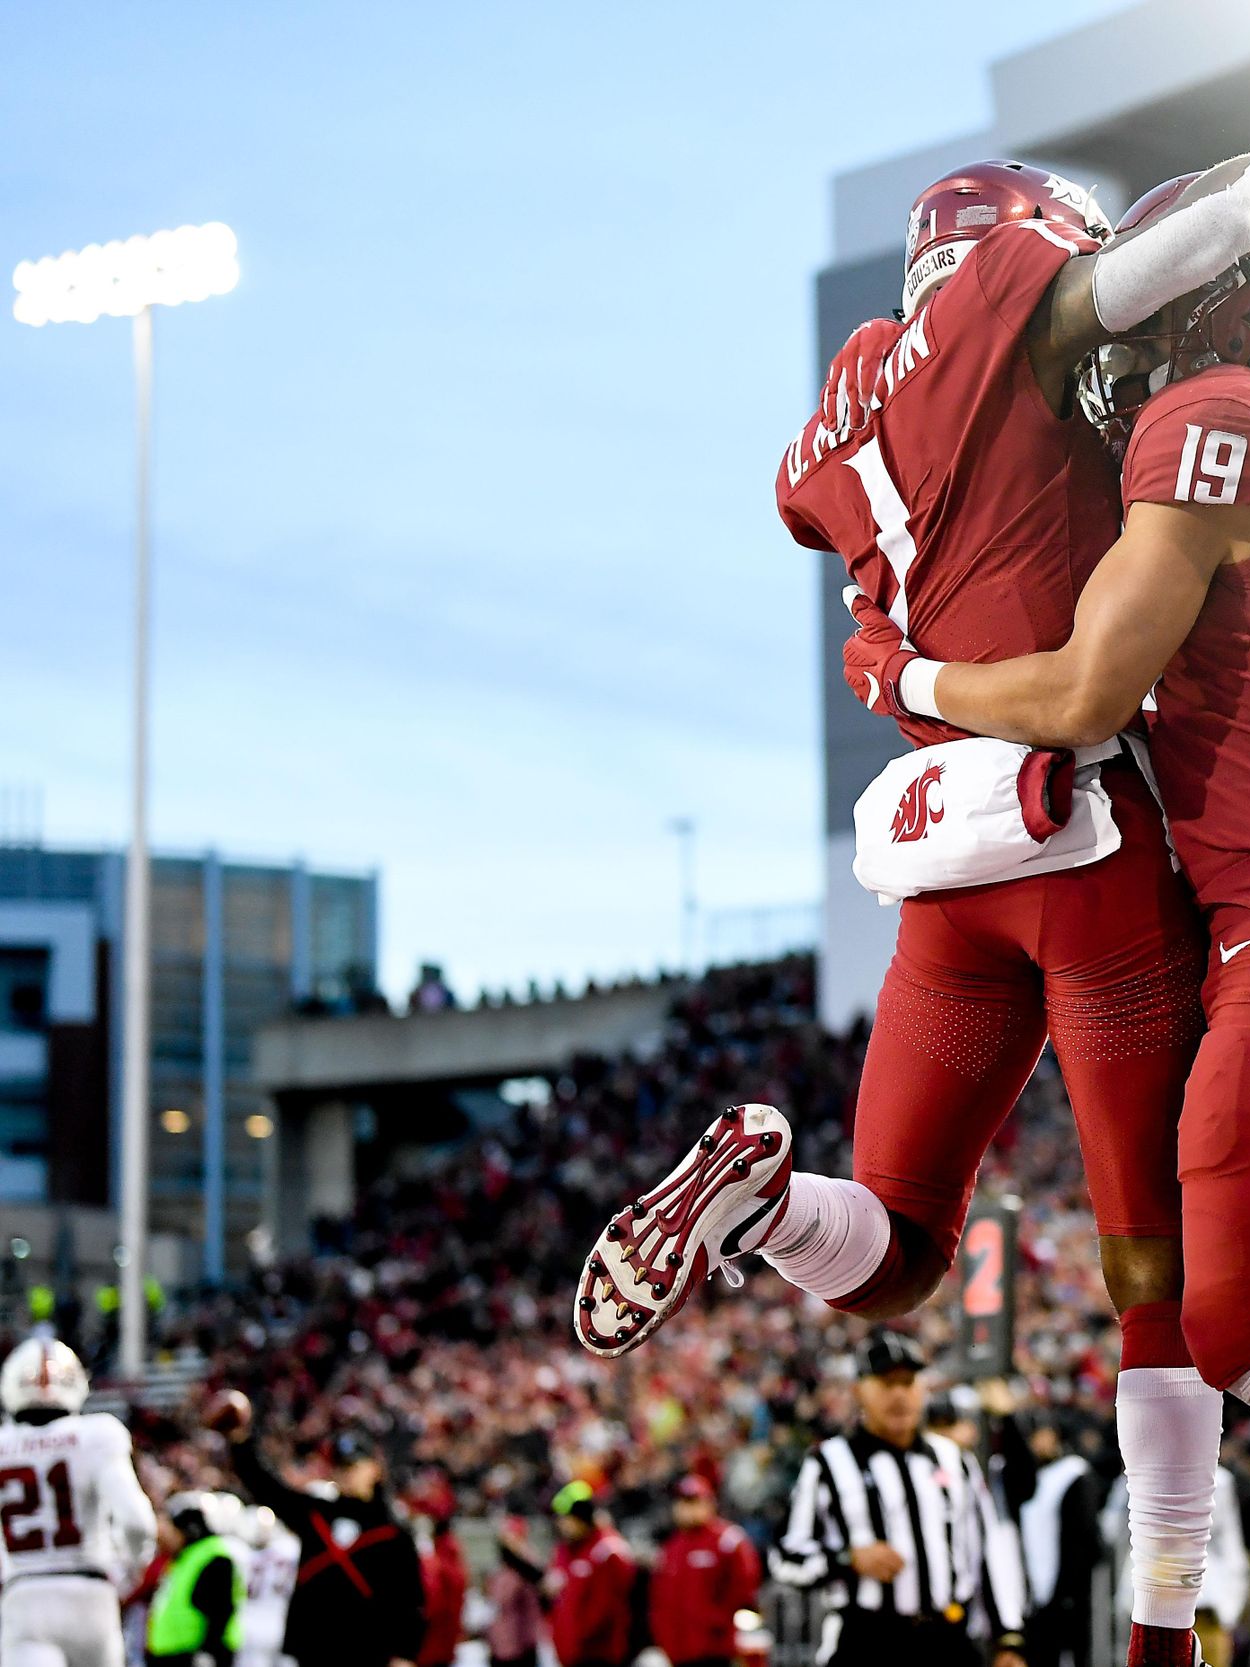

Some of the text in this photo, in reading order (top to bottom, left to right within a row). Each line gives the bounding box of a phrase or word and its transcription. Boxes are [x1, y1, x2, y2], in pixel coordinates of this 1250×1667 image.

[1174, 423, 1248, 505] 19
[841, 434, 917, 638] 1
[963, 1218, 1004, 1318] 2
[0, 1459, 83, 1553] 21
